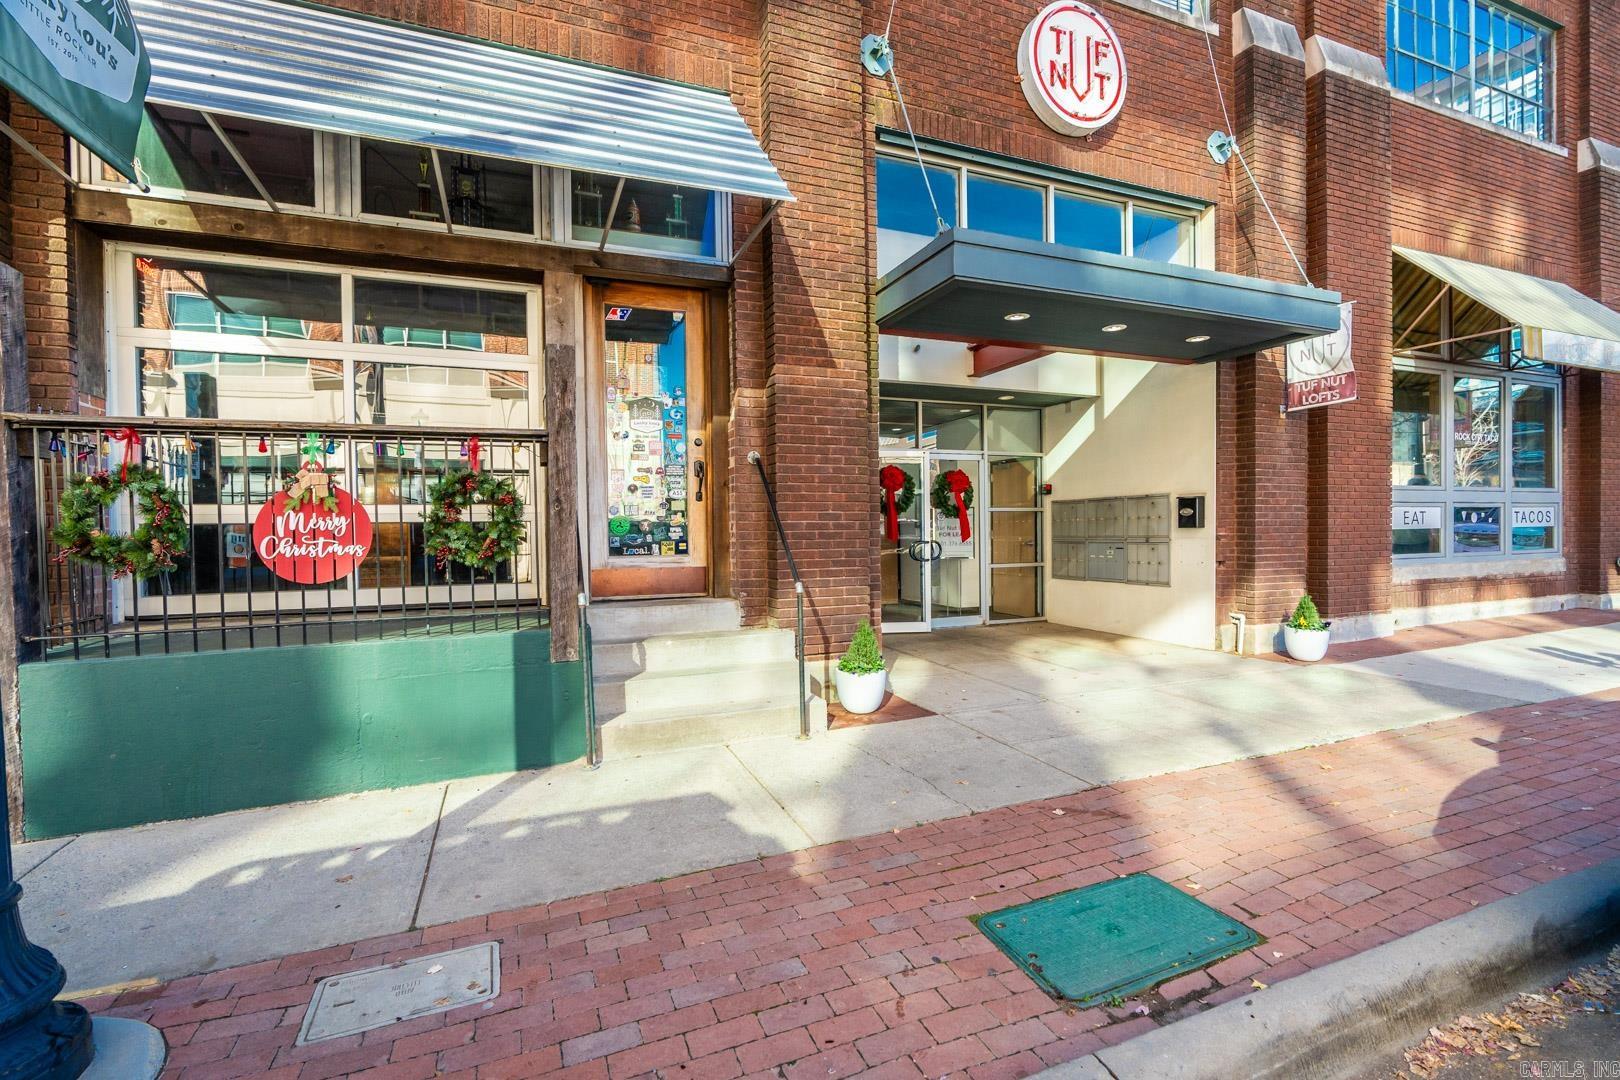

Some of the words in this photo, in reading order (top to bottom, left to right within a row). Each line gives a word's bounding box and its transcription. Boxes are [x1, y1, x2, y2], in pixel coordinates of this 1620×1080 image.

[20, 0, 51, 28] LITTLE
[1295, 380, 1318, 393] TUF
[1321, 374, 1348, 388] NUT
[1302, 389, 1340, 405] LOFTS
[1455, 432, 1471, 441] ROCK
[276, 509, 350, 538] Merry
[1403, 511, 1426, 525] EAT
[1514, 510, 1552, 523] TACOS
[260, 535, 366, 560] Christmas
